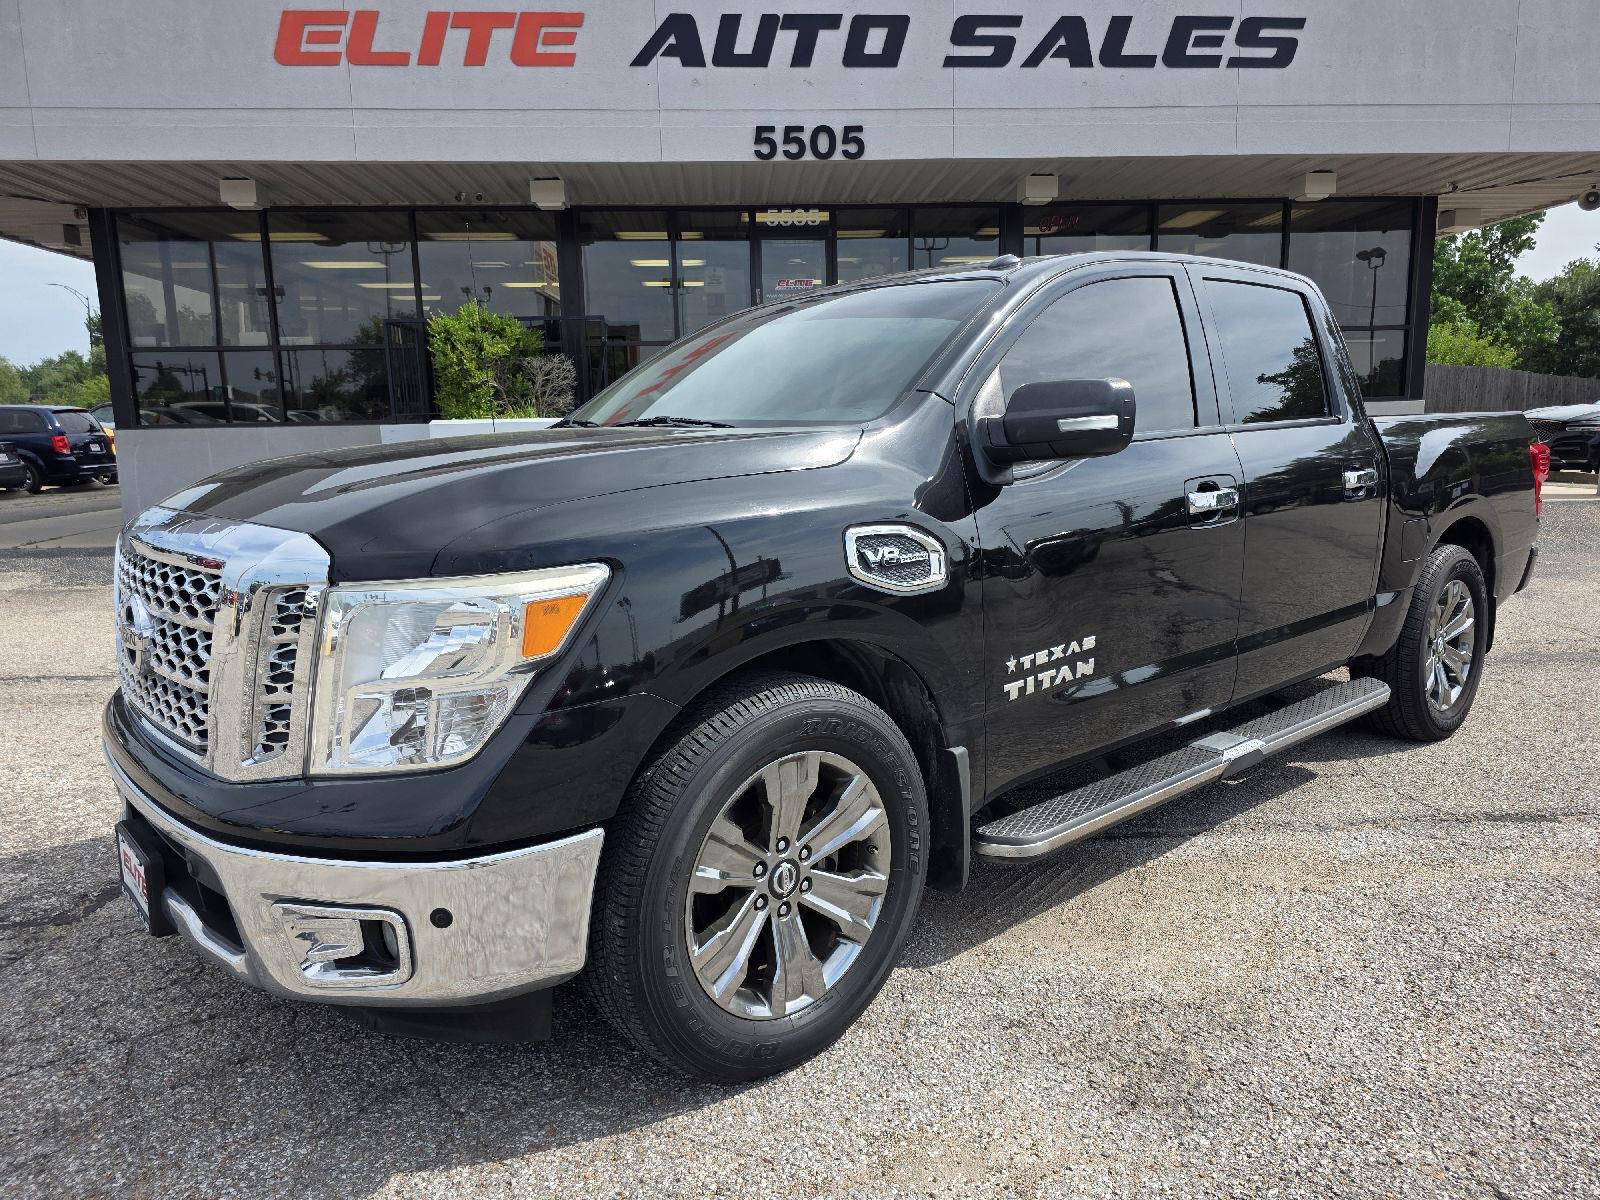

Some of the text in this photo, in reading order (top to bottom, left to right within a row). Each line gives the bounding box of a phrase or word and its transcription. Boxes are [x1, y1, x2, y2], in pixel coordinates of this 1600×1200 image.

[274, 10, 1306, 69] ELITE AUTO SALES
[753, 125, 866, 161] 5505
[767, 208, 821, 227] 5505
[776, 278, 815, 287] ELITE
[860, 546, 900, 567] V8
[1020, 635, 1096, 670] TEXAS
[1003, 657, 1095, 702] TITAN
[799, 716, 923, 875] BRIDGESTONE
[122, 848, 149, 898] ELITE
[663, 944, 782, 1060] DUELER
